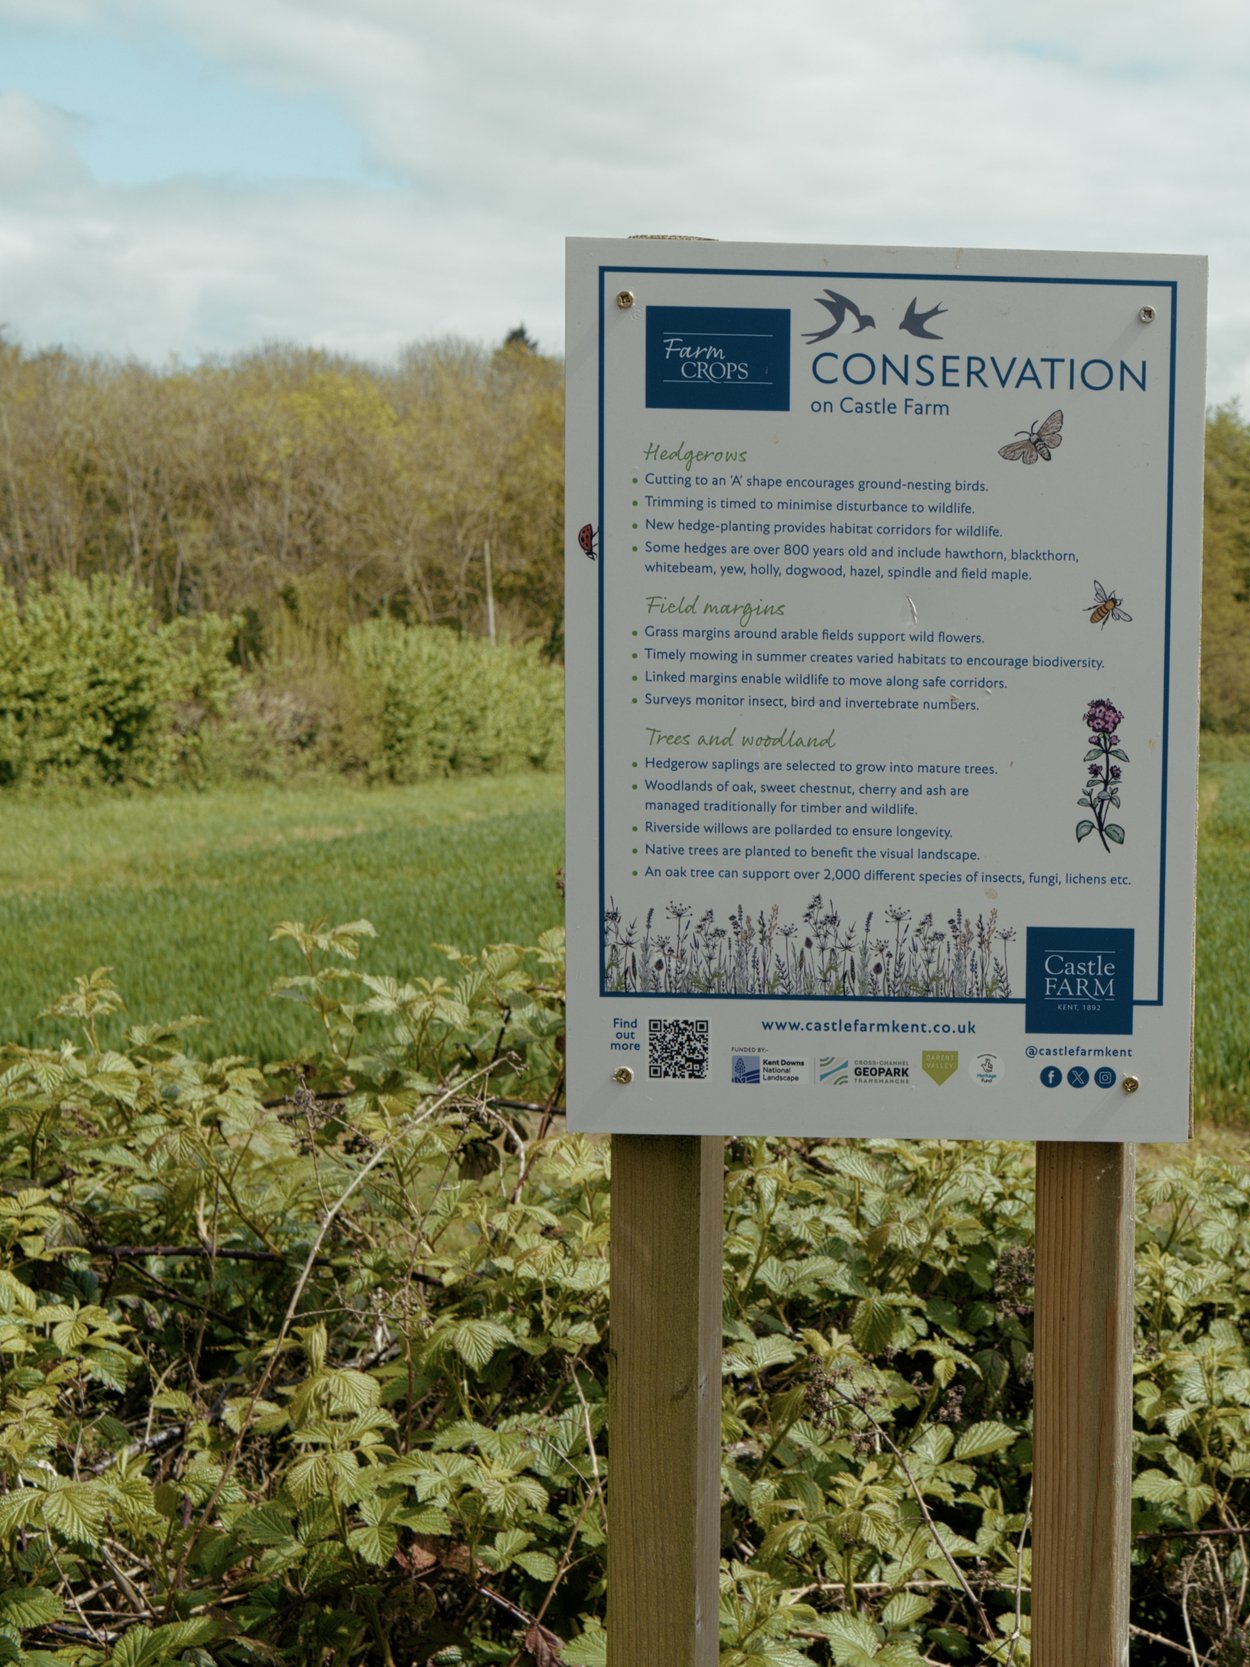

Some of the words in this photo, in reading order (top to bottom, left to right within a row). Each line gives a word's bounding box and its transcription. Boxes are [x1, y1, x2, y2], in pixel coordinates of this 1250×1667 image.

[664, 338, 725, 362] Farm
[680, 362, 750, 383] CROPS
[812, 352, 1146, 392] CONSERVATION
[811, 401, 833, 413] on
[840, 397, 897, 414] Castle
[905, 399, 949, 416] Farm
[643, 441, 747, 471] Hedgerows
[645, 473, 691, 488] Cutting
[696, 477, 708, 485] to
[712, 478, 726, 486] an
[747, 475, 782, 489] shape
[786, 479, 854, 491] encourages
[858, 479, 951, 494] ground-nesting
[956, 480, 988, 492] birds.
[645, 496, 704, 511] Trimming
[708, 498, 717, 508] is
[721, 498, 756, 509] timed
[761, 501, 773, 509] to
[778, 499, 832, 511] minimise
[837, 500, 908, 512] disturbance
[912, 504, 924, 513] to
[928, 502, 975, 514] wildlife.
[646, 519, 674, 530] New
[678, 519, 770, 535] hedge-planting
[774, 522, 826, 535] provides
[830, 522, 873, 534] habitat
[877, 524, 931, 536] corridors
[935, 525, 952, 536] for
[956, 525, 1002, 537] wildlife.
[646, 541, 680, 553] Some
[685, 542, 727, 557] hedges
[731, 546, 749, 555] are
[754, 546, 780, 555] over
[784, 544, 809, 556] 800
[813, 548, 844, 559] years
[848, 546, 867, 557] old
[872, 546, 893, 557] and
[898, 547, 941, 558] include
[946, 548, 1006, 561] hawthorn,
[1011, 549, 1078, 563] blackthorn,
[645, 562, 716, 575] whitebeam,
[720, 566, 746, 576] yew,
[751, 564, 781, 577] holly,
[786, 564, 846, 578] dogwood,
[851, 565, 884, 579] hazel,
[888, 567, 931, 580] spindle
[935, 568, 957, 579] and
[962, 568, 987, 579] field
[992, 569, 1031, 582] maple.
[646, 595, 700, 614] Field
[704, 599, 785, 627] margins
[645, 626, 678, 637] Grass
[683, 628, 730, 641] margins
[734, 628, 777, 639] around
[781, 629, 818, 640] arable
[822, 629, 853, 641] fields
[858, 633, 905, 644] support
[909, 631, 934, 642] wild
[938, 631, 984, 643] flowers.
[644, 648, 686, 663] Timely
[690, 650, 738, 664] mowing
[742, 650, 752, 661] in
[757, 653, 806, 662] summer
[810, 654, 853, 663] creates
[857, 653, 893, 664] varied
[898, 653, 946, 665] habitats
[950, 657, 962, 665] to
[967, 658, 1028, 669] encourage
[1033, 656, 1104, 671] biodiversity.
[646, 671, 685, 682] Linked
[690, 673, 737, 686] margins
[741, 673, 781, 684] enable
[785, 674, 828, 685] wildlife
[833, 677, 845, 685] to
[850, 678, 882, 686] move
[886, 676, 919, 690] along
[923, 676, 946, 687] safe
[950, 677, 1007, 689] corridors.
[646, 728, 690, 745] Trees
[698, 727, 736, 746] and
[742, 728, 836, 748] woodland
[646, 757, 708, 771] Hedgerow
[712, 759, 759, 773] saplings
[764, 762, 782, 771] are
[786, 760, 835, 771] selected
[840, 763, 852, 772] to
[856, 764, 886, 775] grow
[890, 762, 913, 773] into
[918, 765, 960, 774] mature
[965, 766, 997, 774] trees.
[645, 779, 712, 792] Woodlands
[717, 781, 729, 792] of
[732, 781, 756, 794] oak,
[761, 785, 795, 793] sweet
[800, 783, 854, 796] chestnut,
[859, 784, 896, 797] cherry
[901, 785, 922, 795] and
[927, 785, 946, 795] ash
[950, 788, 968, 796] are
[646, 821, 700, 833] Riverside
[704, 823, 748, 834] willows
[752, 826, 770, 834] are
[775, 824, 831, 837] pollarded
[836, 827, 848, 836] to
[852, 828, 892, 837] ensure
[897, 826, 952, 840] longevity.
[646, 844, 684, 855] Native
[689, 847, 718, 856] trees
[722, 848, 741, 856] are
[745, 846, 790, 859] planted
[795, 849, 807, 857] to
[811, 846, 853, 858] benefit
[857, 848, 876, 859] the
[880, 848, 913, 859] visual
[918, 849, 979, 863] landscape.
[645, 866, 661, 877] An
[665, 866, 687, 877] oak
[691, 869, 714, 878] tree
[719, 870, 738, 878] can
[743, 870, 790, 881] support
[794, 871, 820, 879] over
[824, 869, 860, 882] 2,000
[864, 870, 915, 881] different
[919, 872, 962, 884] species
[966, 871, 979, 882] of
[982, 872, 1025, 885] insects,
[1029, 872, 1061, 886] fungi,
[1066, 873, 1106, 884] lichens
[1110, 876, 1131, 885] etc.
[1045, 955, 1115, 976] Castle
[1045, 978, 1114, 1001] FARM
[614, 1018, 637, 1028] Find
[762, 1019, 976, 1033] www.castlefarmkent.co.uk
[611, 1043, 640, 1051] more
[1025, 1046, 1132, 1058] @castlefarmkent
[854, 1067, 909, 1077] GEOPARK
